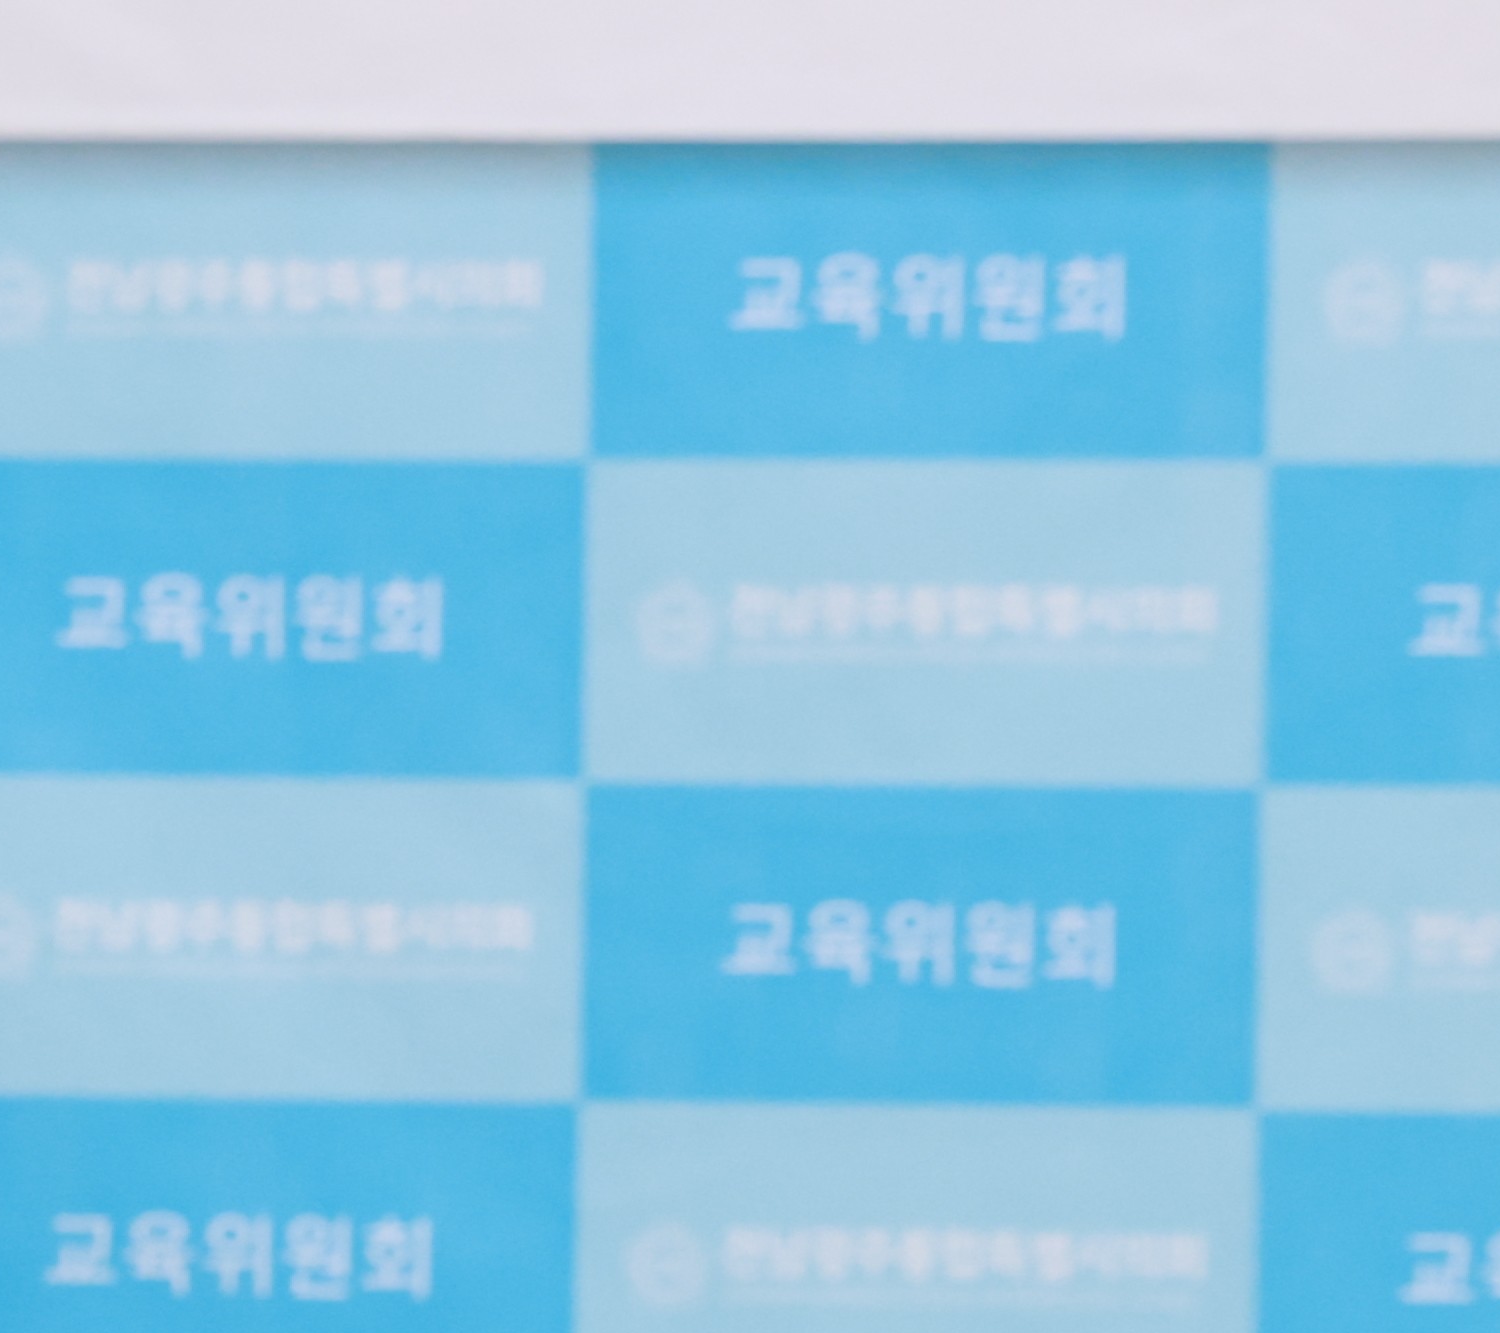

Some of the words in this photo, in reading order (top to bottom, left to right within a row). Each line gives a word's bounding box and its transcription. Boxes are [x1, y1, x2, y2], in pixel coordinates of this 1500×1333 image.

[729, 249, 1129, 345] 교육위원회
[56, 569, 447, 664] 교육위원회
[720, 897, 1119, 992] 교육위원회
[44, 1208, 437, 1304] 교육위원회
